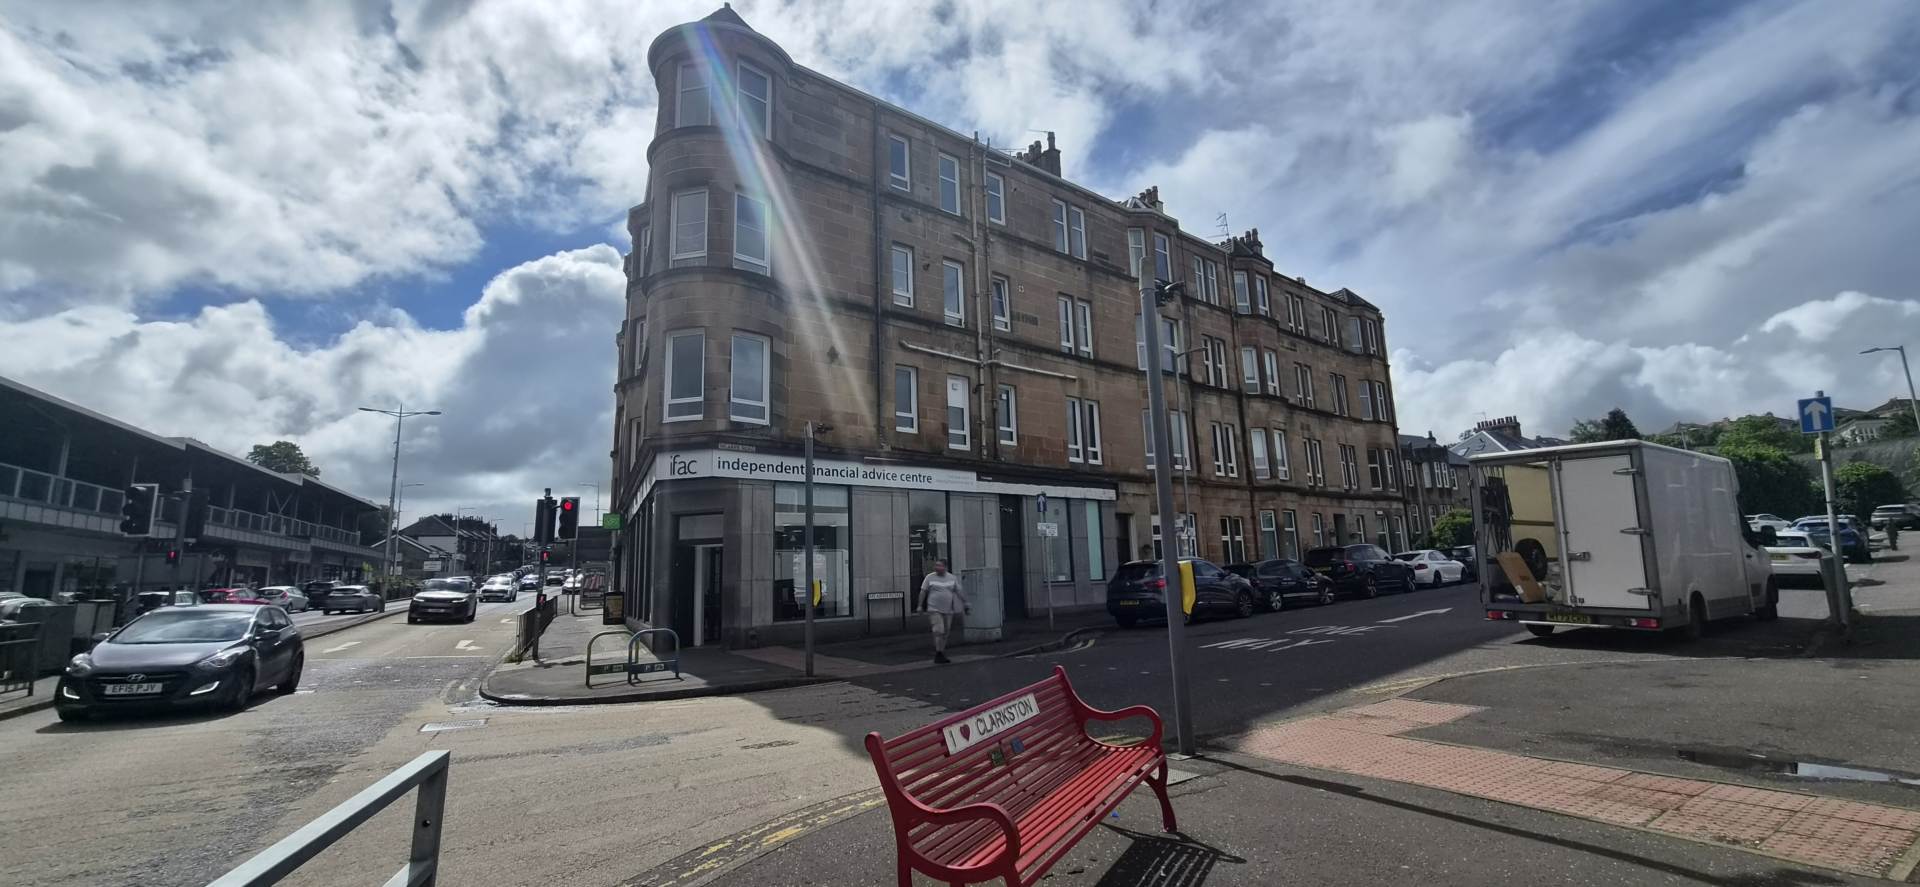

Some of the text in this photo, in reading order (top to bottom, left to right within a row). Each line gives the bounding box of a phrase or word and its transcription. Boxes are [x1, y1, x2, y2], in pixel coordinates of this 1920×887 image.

[669, 454, 698, 477] ifac
[717, 456, 806, 476] independent
[808, 462, 860, 480] inancial
[862, 467, 898, 482] advice
[899, 472, 933, 484] centre
[949, 697, 1034, 748] I CLARKSTON
